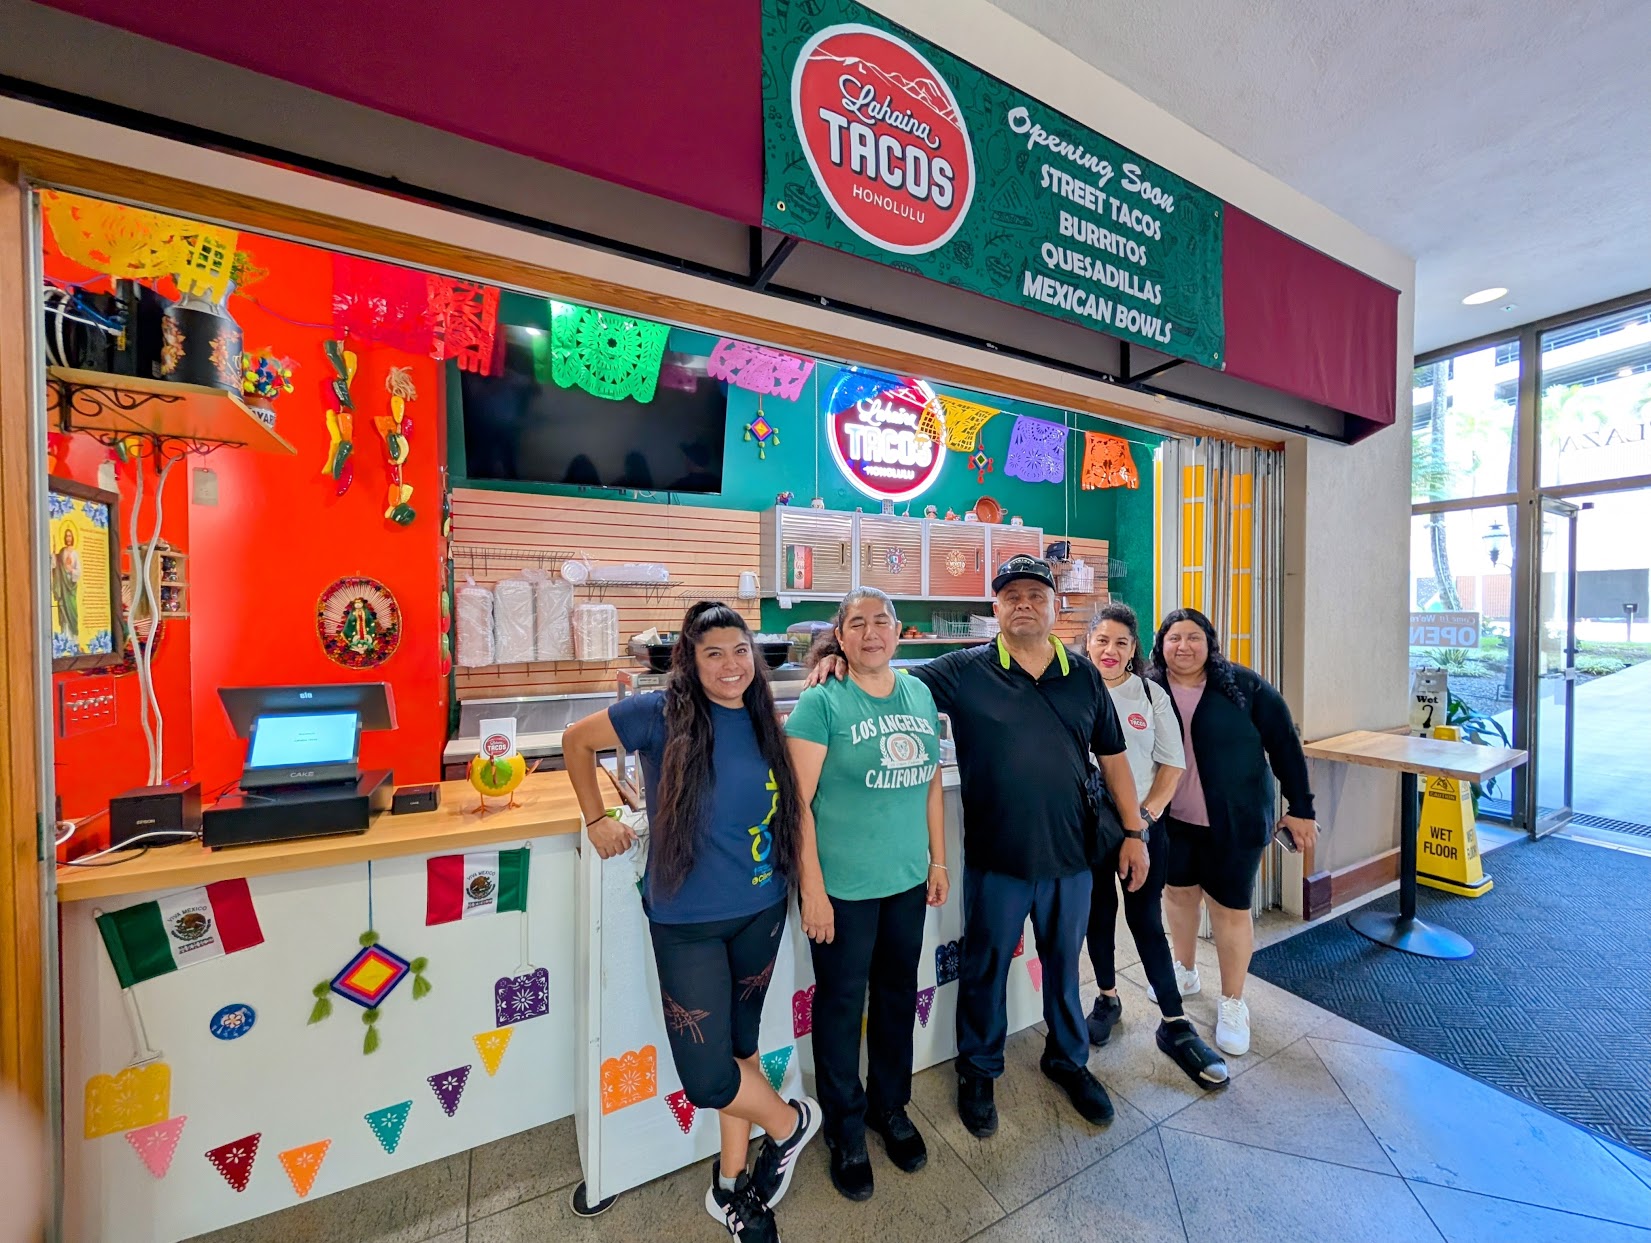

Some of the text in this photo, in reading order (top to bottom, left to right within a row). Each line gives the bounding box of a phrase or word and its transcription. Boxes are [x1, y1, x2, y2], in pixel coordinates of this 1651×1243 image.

[838, 74, 940, 149] Lahaina
[818, 107, 955, 210] TACOS
[1008, 106, 1175, 214] Opening Soon
[852, 183, 926, 224] HONOLULU
[1041, 163, 1162, 241] STREET TACOS
[1059, 210, 1147, 266] BURRITOS
[1041, 242, 1162, 305] QUESADILLAS
[1023, 270, 1173, 344] MEXICAN BOWLS
[844, 422, 934, 468] TACOS
[862, 465, 916, 481] HONOLULU
[1416, 695, 1439, 704] Wet
[850, 714, 935, 745] LOS ANGELES
[1429, 792, 1456, 801] CAUTION
[1423, 841, 1458, 861] FLOOR
[1430, 825, 1453, 842] WET
[467, 872, 478, 881] VIVA
[167, 905, 208, 922] VIVA MEXICO
